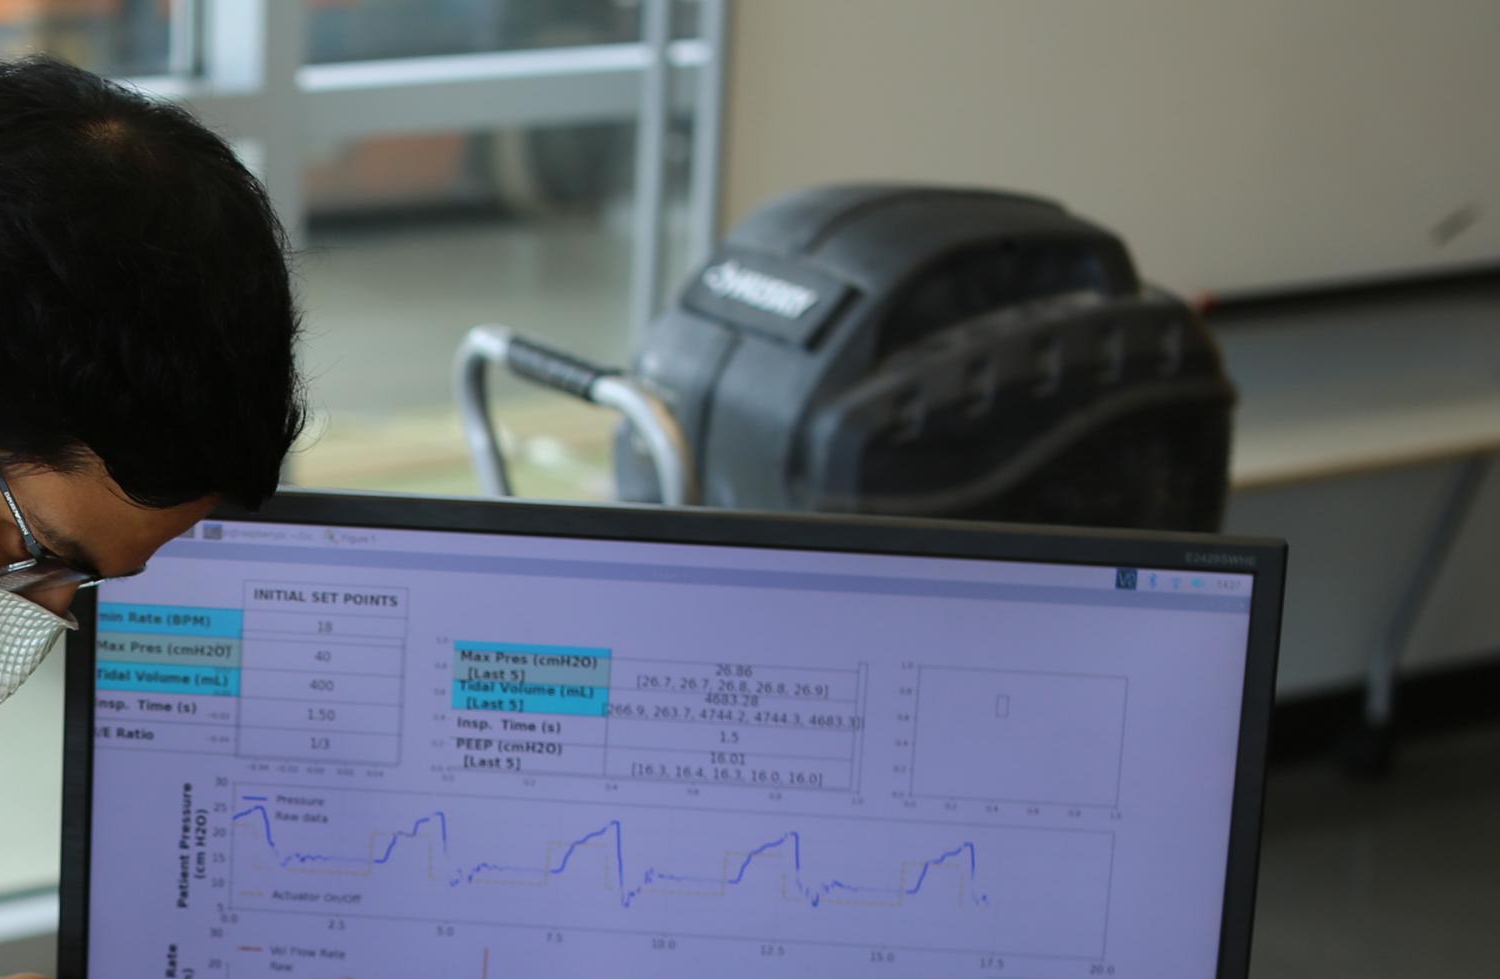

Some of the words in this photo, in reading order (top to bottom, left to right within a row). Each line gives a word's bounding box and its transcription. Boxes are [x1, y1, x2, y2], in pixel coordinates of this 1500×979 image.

[253, 588, 305, 603] INITIAL
[311, 591, 339, 605] SET
[343, 592, 399, 608] POINTS
[127, 612, 163, 625] Rate
[165, 613, 211, 630] (BPM)
[317, 621, 333, 634] 18
[130, 641, 163, 656] Pres
[167, 642, 233, 660] (cmH2O)
[314, 650, 332, 663] 40
[460, 649, 491, 662] Max
[495, 652, 528, 666] Pres
[533, 654, 599, 671] (cmH2O)
[135, 670, 191, 686] Volume
[194, 673, 229, 689] (mL)
[468, 667, 501, 681] [Last
[505, 669, 526, 683] 5]
[715, 663, 753, 678] 26.86
[309, 679, 335, 693] 400
[460, 679, 495, 693] Tidal
[500, 681, 556, 696] Volume
[560, 685, 595, 700] (mL)
[137, 699, 173, 713] Time
[176, 701, 198, 716] (s)
[466, 697, 500, 711] [Last
[504, 699, 525, 713] 5]
[307, 707, 337, 722] 1.50
[456, 716, 493, 732] Insp.
[501, 718, 537, 732] Time
[541, 720, 562, 734] (s)
[116, 727, 155, 742] Ratio
[310, 736, 331, 751] 1/3
[719, 730, 740, 744] 1.5
[455, 736, 493, 751] PEEP
[497, 739, 563, 757] (cmH2O)
[463, 753, 499, 769] [Last
[505, 756, 522, 772] 5]
[178, 781, 193, 850] Pressure
[194, 807, 209, 848] H2O)
[194, 850, 207, 880] (cm
[175, 854, 190, 909] Patient
[271, 889, 321, 902] Actuator
[165, 943, 178, 979] Rate
